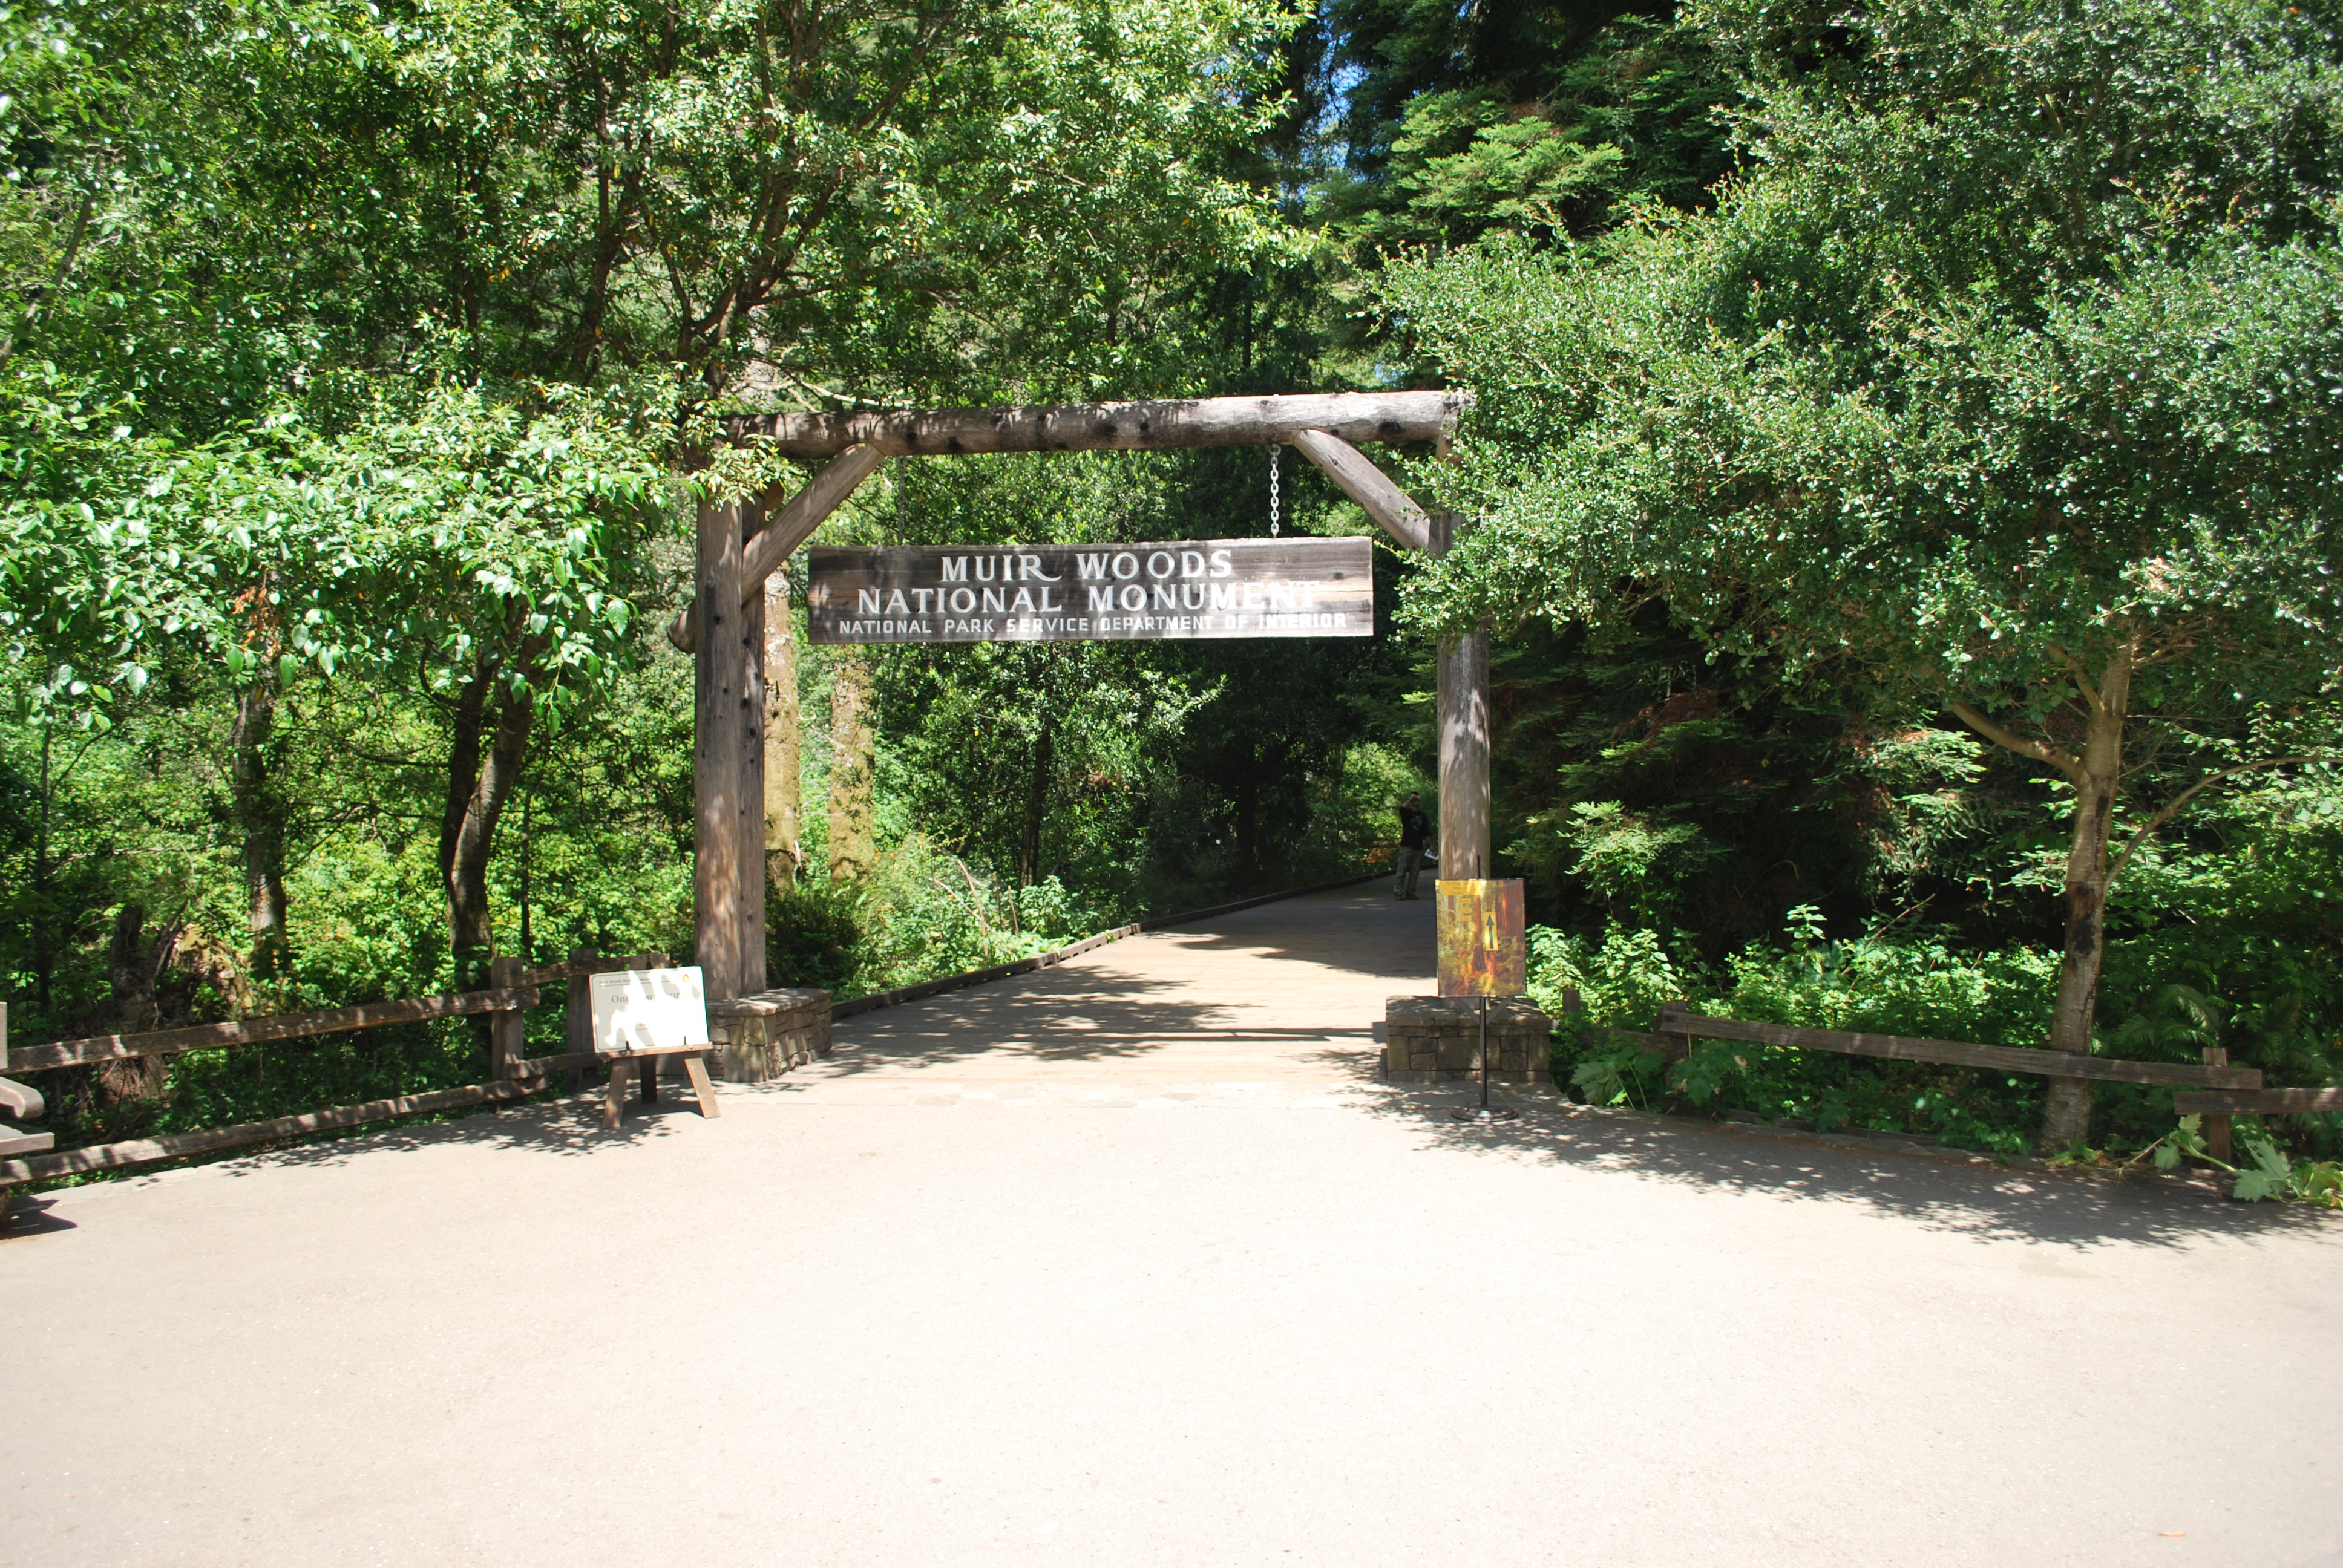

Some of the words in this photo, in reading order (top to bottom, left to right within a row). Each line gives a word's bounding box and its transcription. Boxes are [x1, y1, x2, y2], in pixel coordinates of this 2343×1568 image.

[941, 554, 1062, 582] MUIR
[1075, 549, 1232, 580] WOODS
[857, 586, 1062, 614] NATIONAL
[1088, 580, 1320, 612] MONUMENT
[839, 619, 932, 634] NATIONAL
[944, 618, 995, 633] PARK
[1006, 617, 1088, 633] SERVICE
[1100, 615, 1214, 632] DEPARTMENT
[1225, 614, 1249, 629] OF
[1259, 612, 1347, 629] INTERIOR
